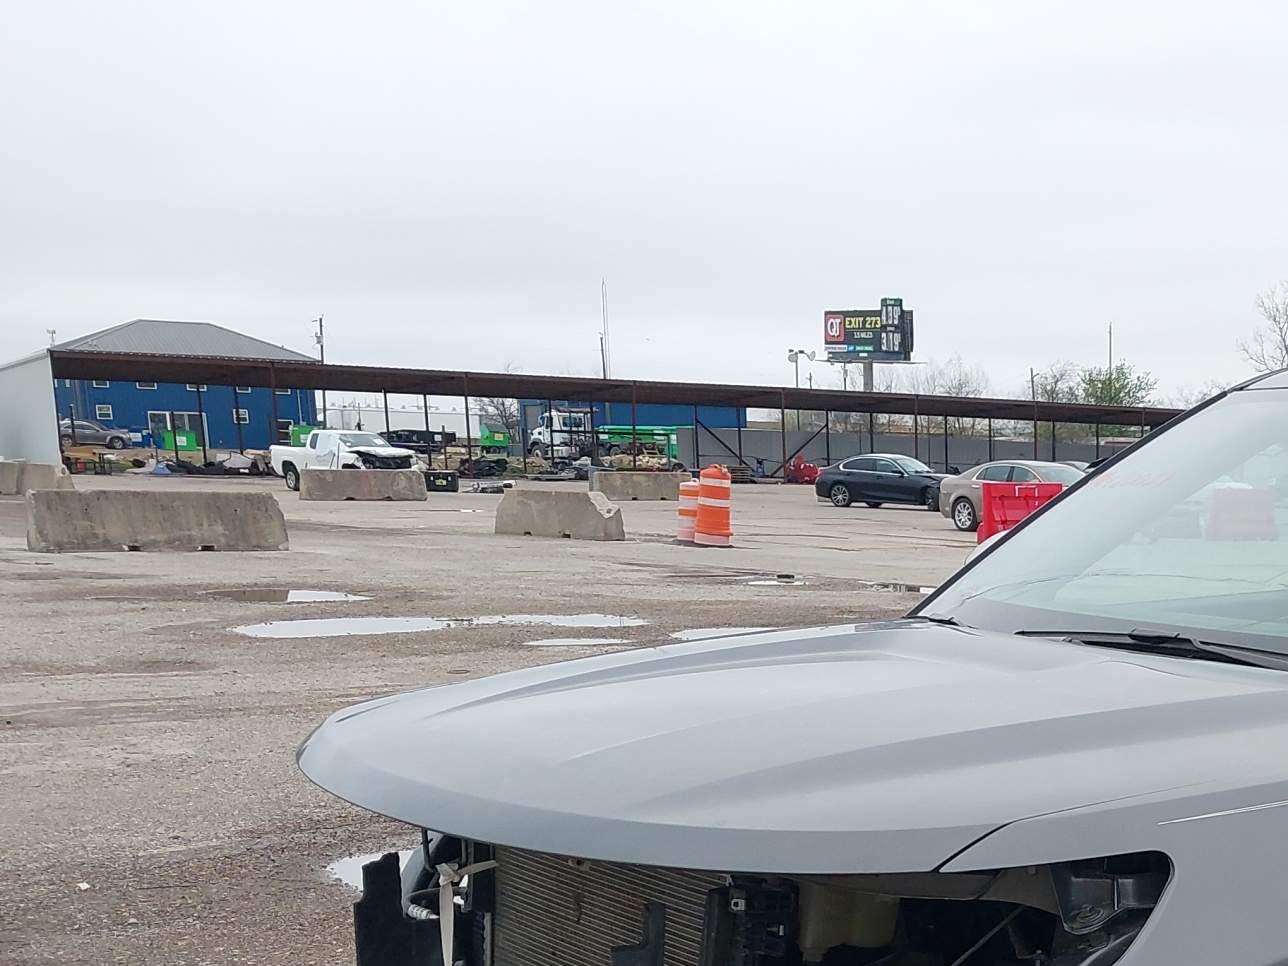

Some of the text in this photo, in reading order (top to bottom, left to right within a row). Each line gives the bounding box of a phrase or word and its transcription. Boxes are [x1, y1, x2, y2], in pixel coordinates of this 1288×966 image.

[827, 318, 841, 336] QT
[845, 316, 881, 328] EXIT 273
